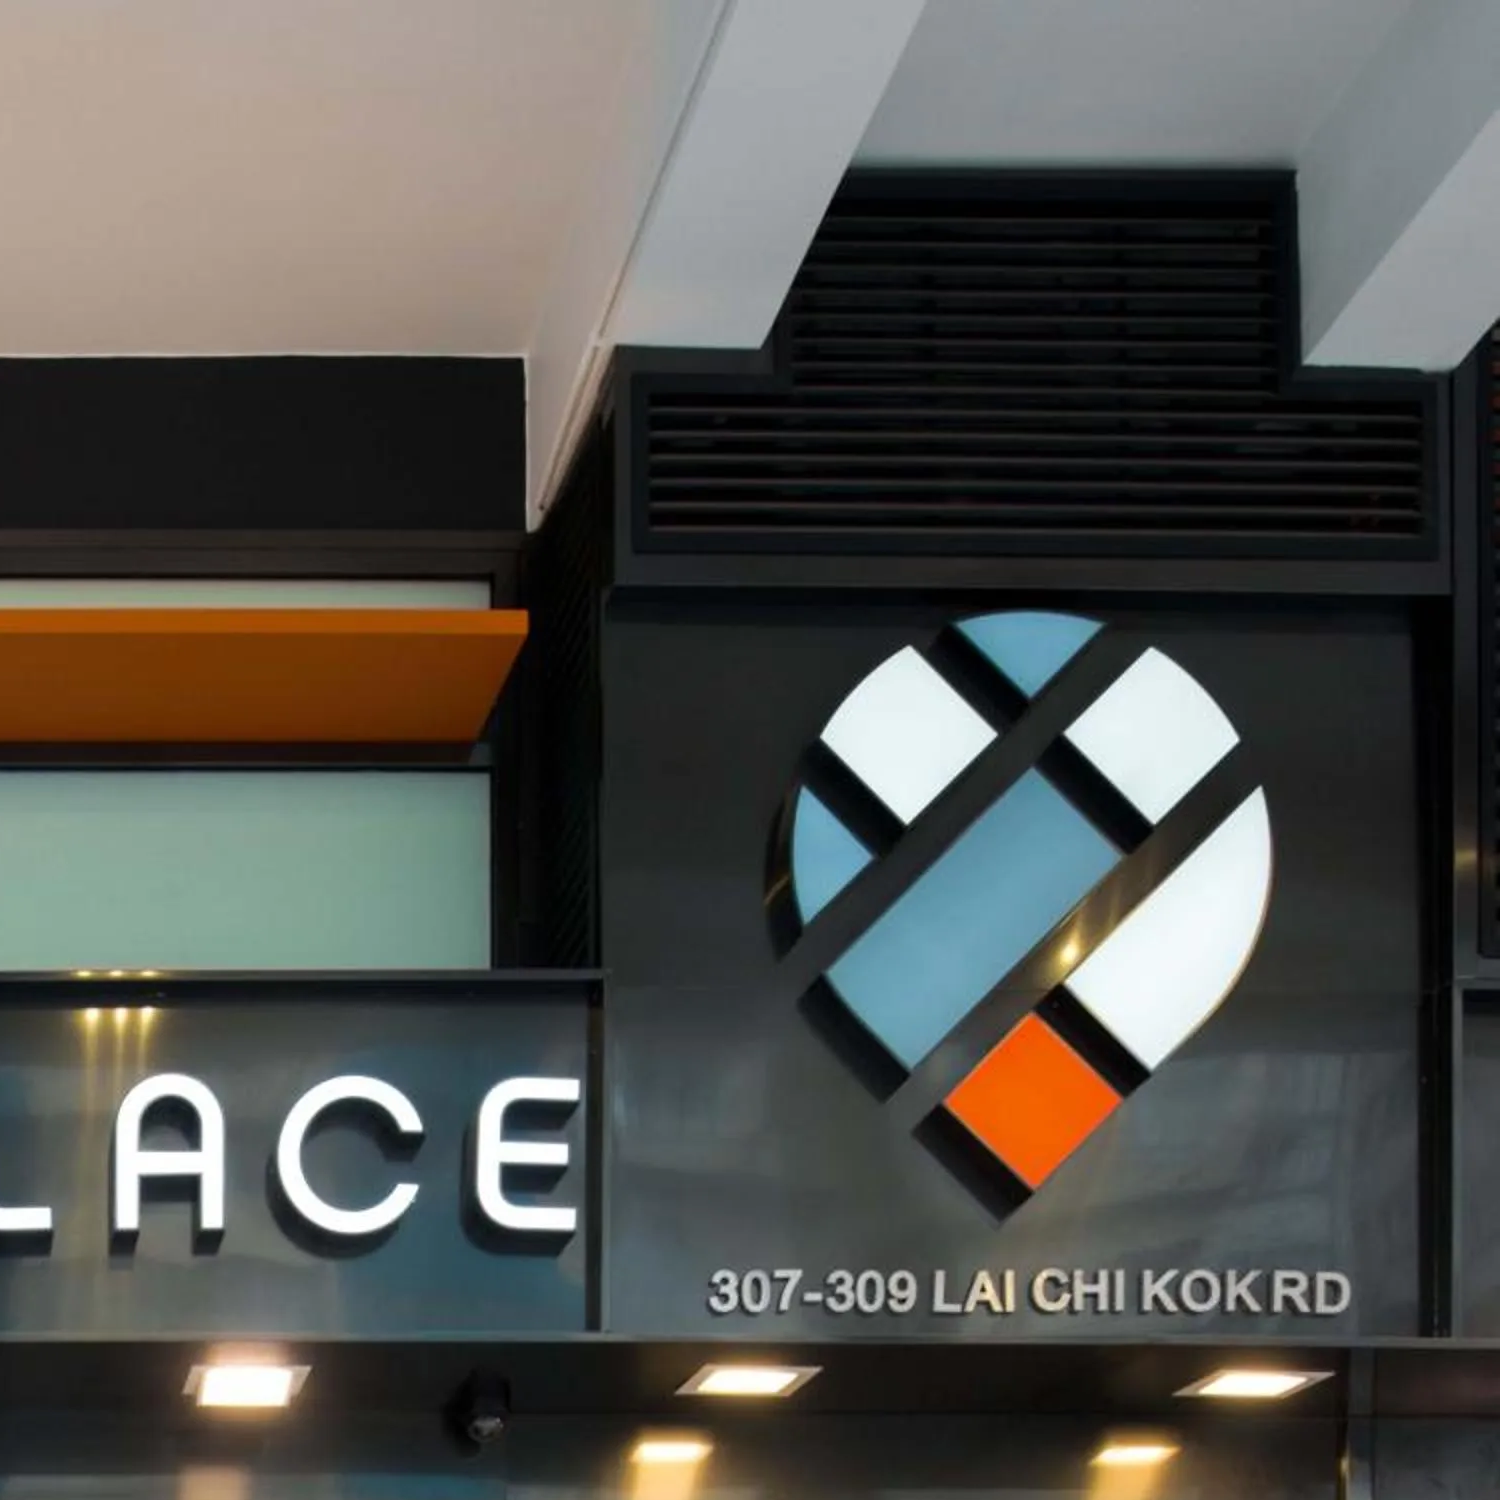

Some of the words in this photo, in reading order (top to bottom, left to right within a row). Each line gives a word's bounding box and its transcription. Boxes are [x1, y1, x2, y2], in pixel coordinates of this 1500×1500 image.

[708, 1267, 918, 1314] 307-309
[932, 1267, 1017, 1314] LAI
[1032, 1266, 1126, 1313] CHI
[1142, 1268, 1262, 1313] KOK
[1272, 1269, 1352, 1315] RD
